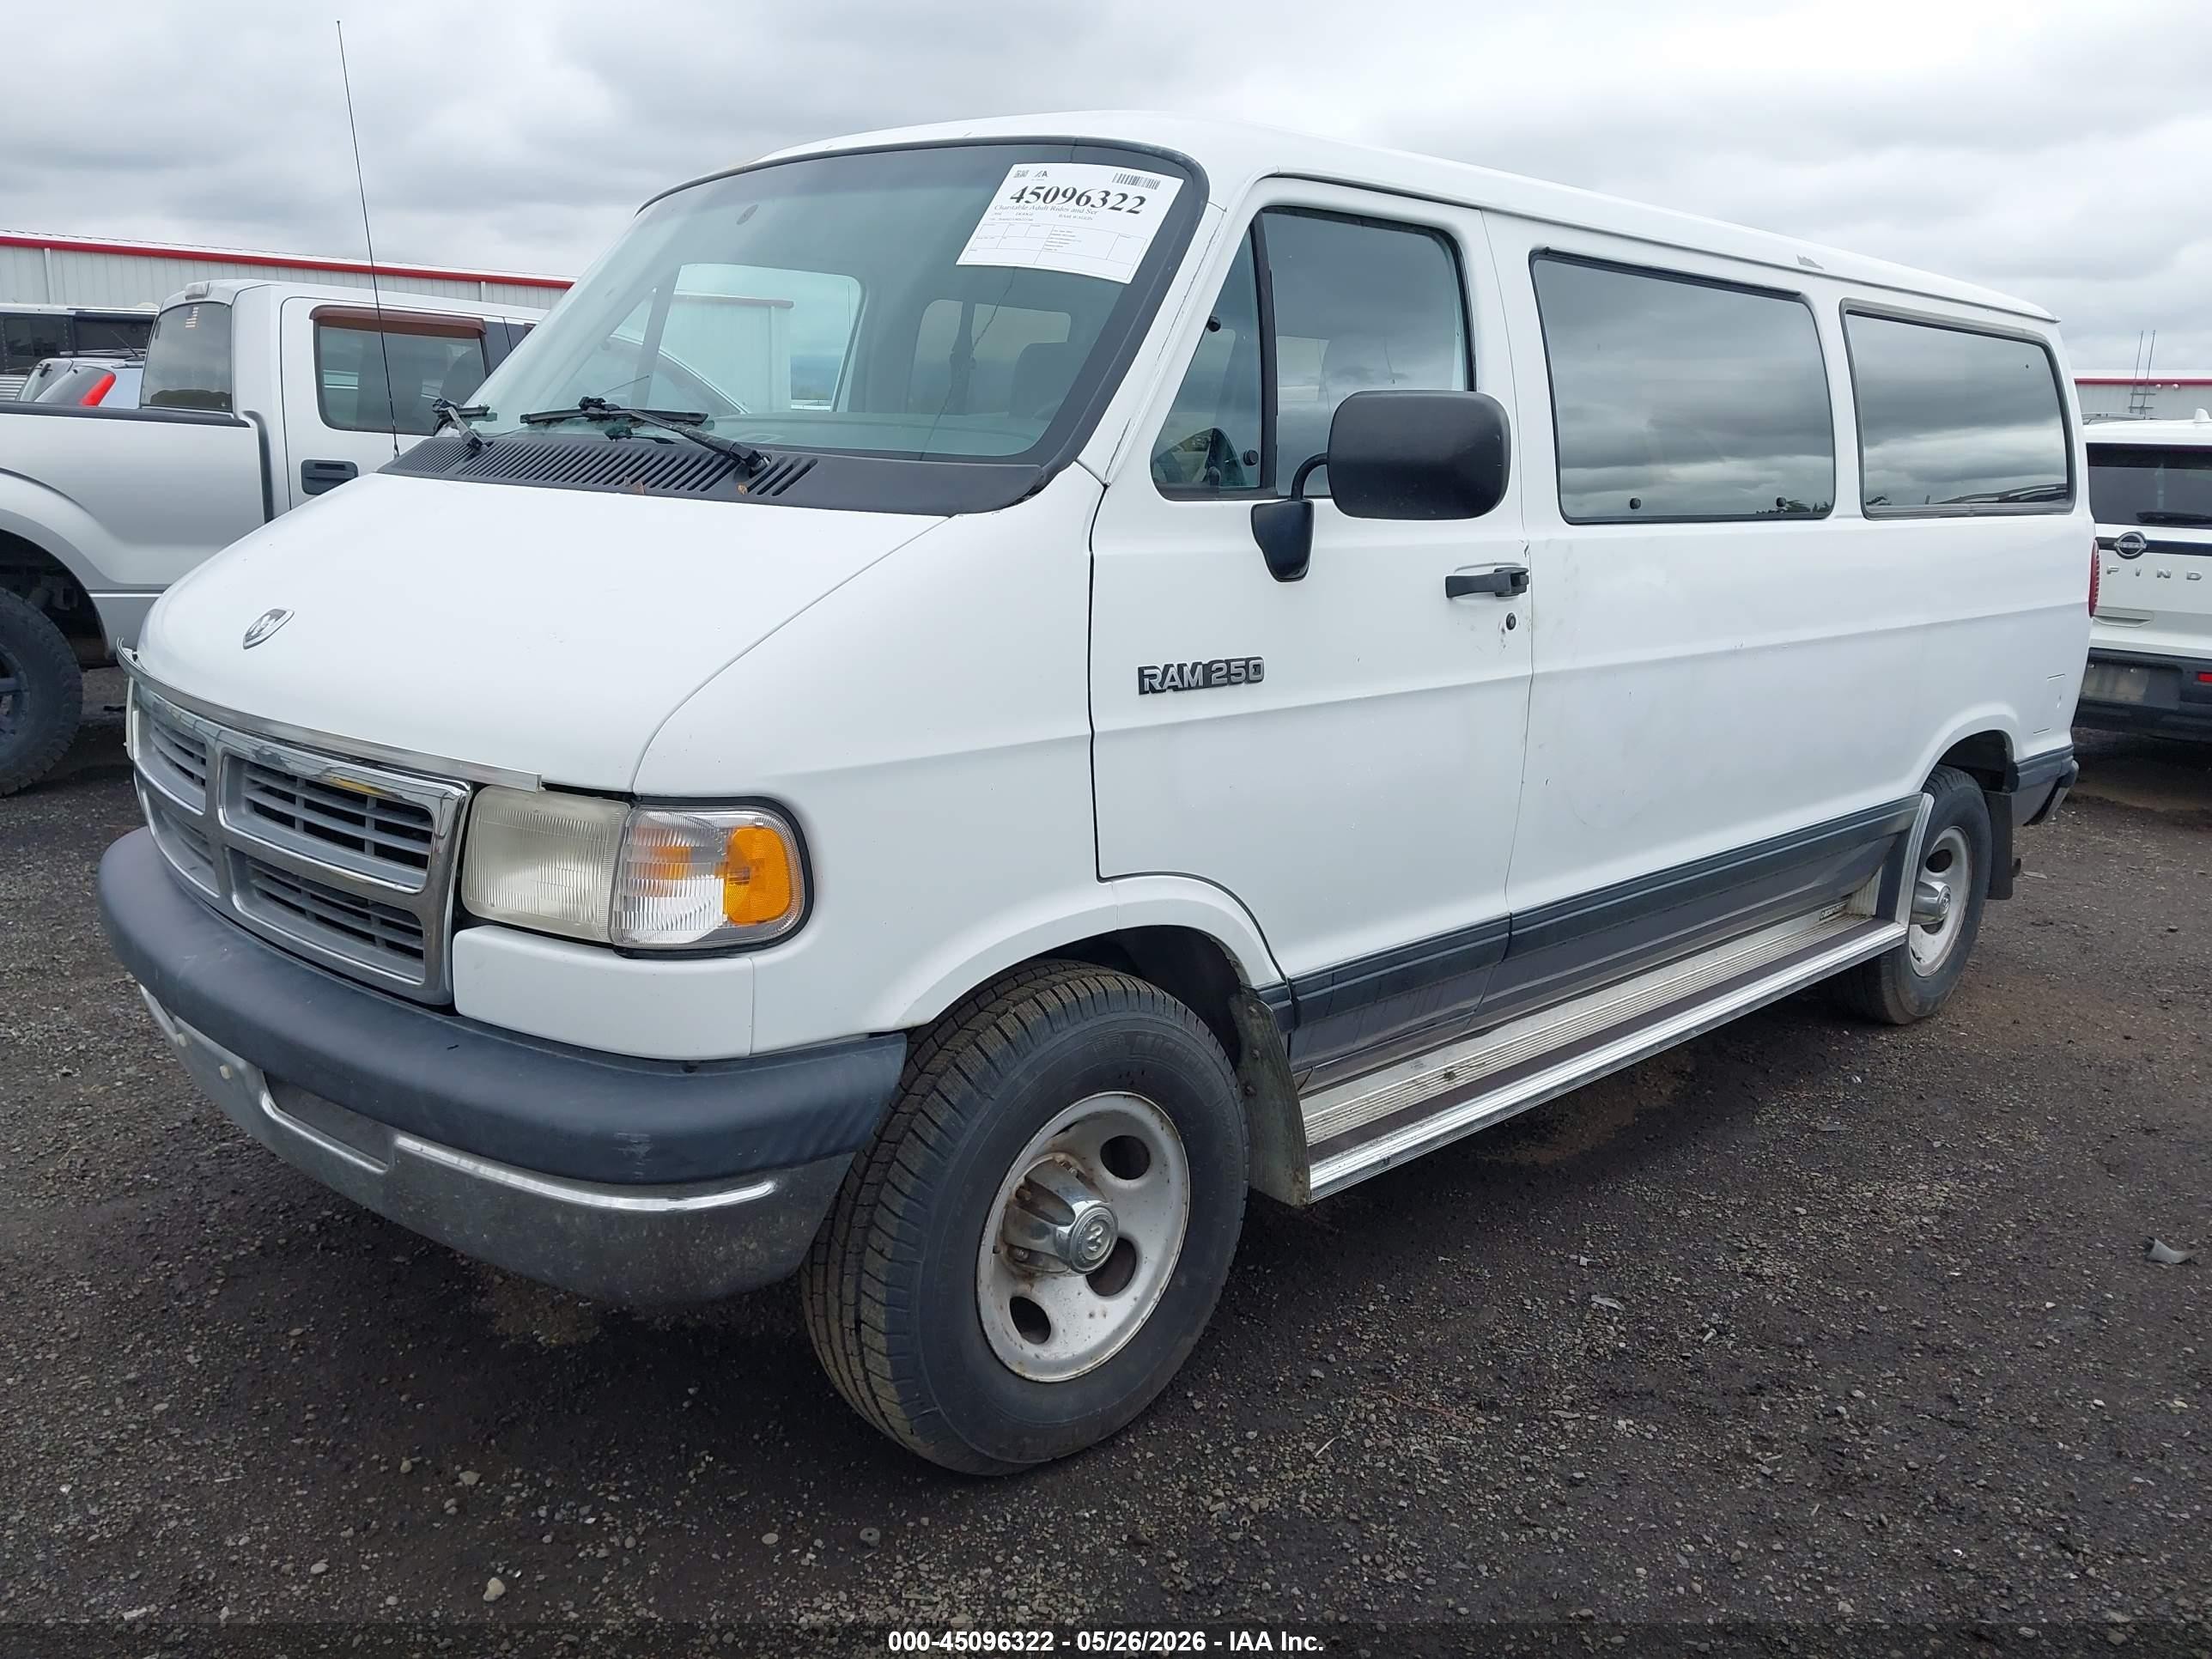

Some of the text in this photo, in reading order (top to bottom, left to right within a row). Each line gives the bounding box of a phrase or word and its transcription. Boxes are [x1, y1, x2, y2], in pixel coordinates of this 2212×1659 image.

[1010, 185, 1146, 214] 45096322
[2106, 565, 2203, 581] FIND
[1138, 656, 1264, 694] RAM 250
